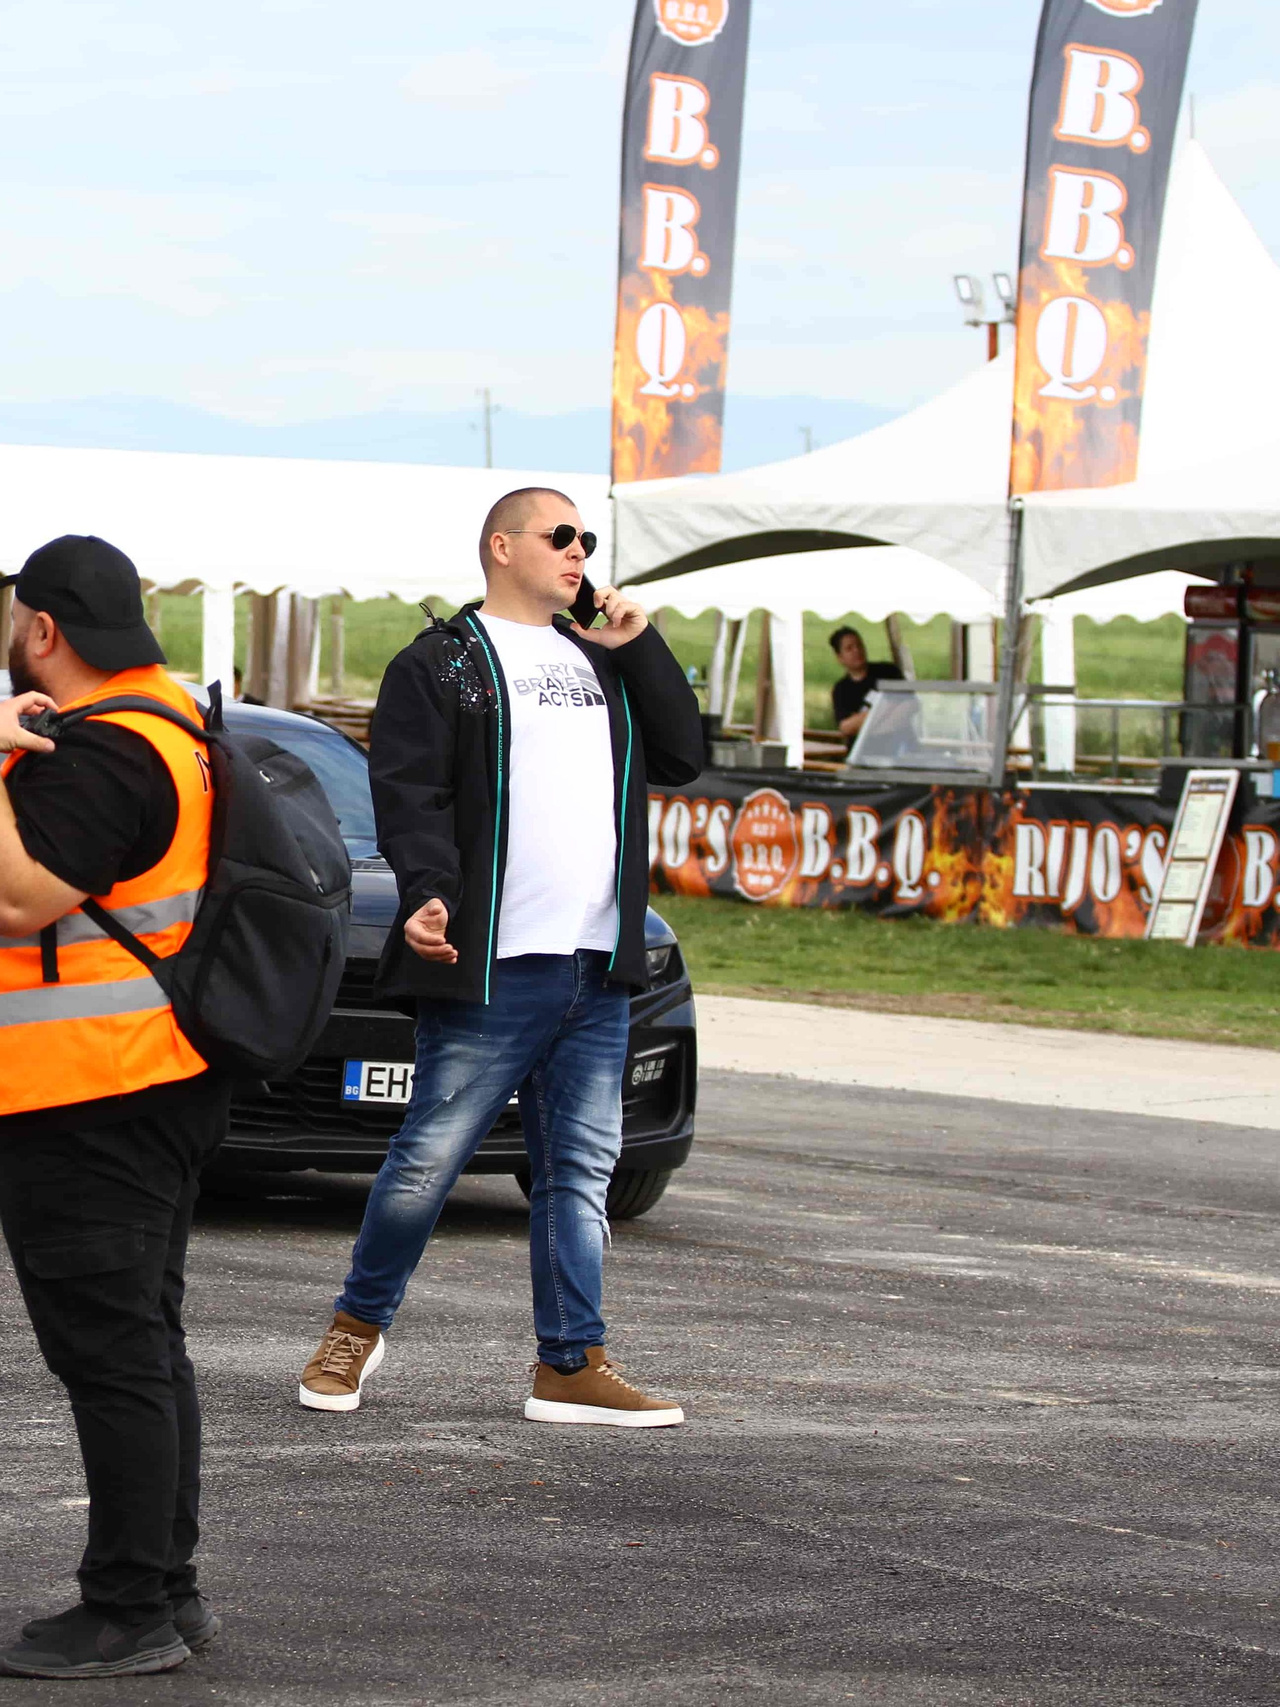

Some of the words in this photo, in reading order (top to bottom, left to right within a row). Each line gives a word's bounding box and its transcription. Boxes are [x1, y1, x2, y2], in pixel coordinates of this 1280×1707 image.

[535, 662, 570, 677] TRY
[538, 690, 584, 708] ACTS
[799, 804, 942, 899] B.B.Q.
[1013, 823, 1167, 910] RIJO'S
[345, 1085, 359, 1096] BG
[366, 1066, 409, 1098] EH
